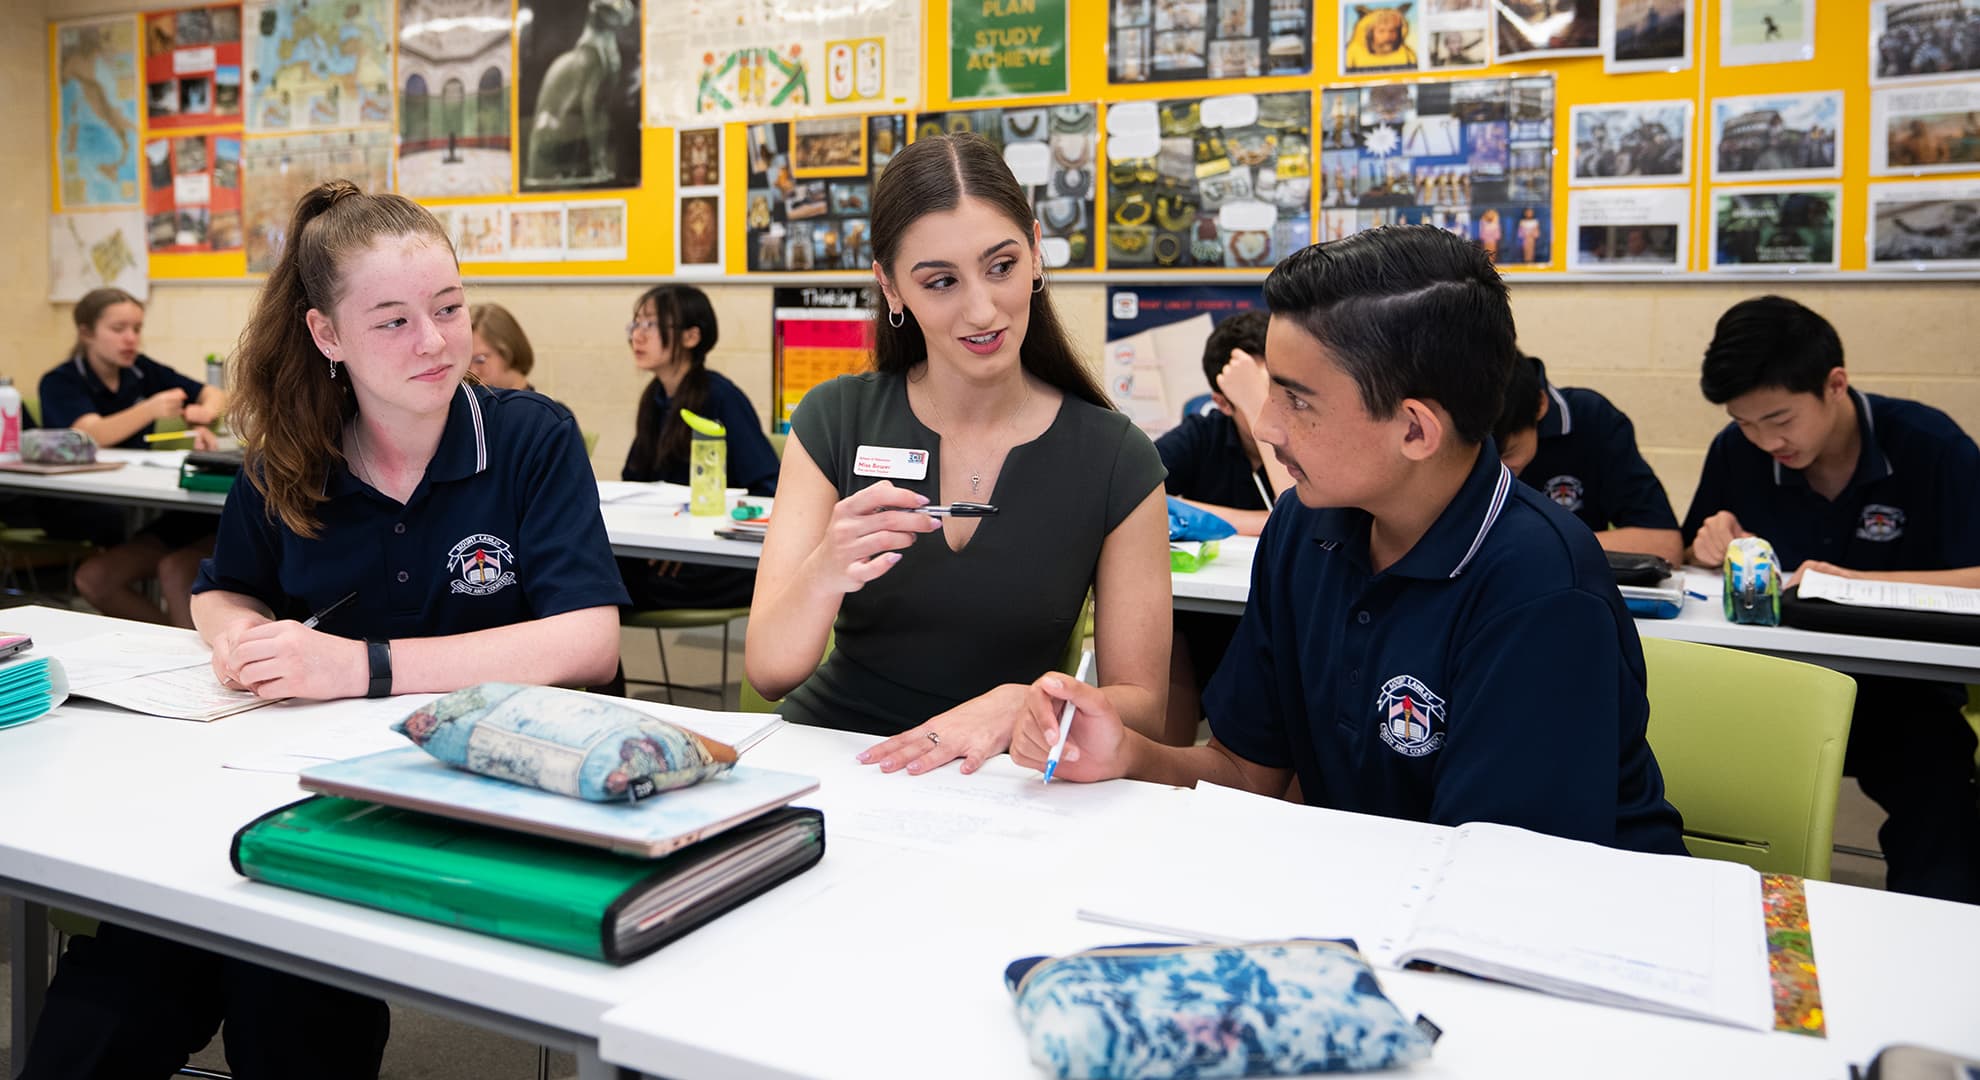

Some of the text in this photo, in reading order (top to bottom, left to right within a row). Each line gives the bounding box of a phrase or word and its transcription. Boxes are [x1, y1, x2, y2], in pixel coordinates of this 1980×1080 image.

[982, 0, 1035, 16] PLAN
[975, 25, 1043, 49] STUDY
[966, 46, 1052, 71] ACHIEVE
[801, 287, 857, 309] Thinking
[1407, 679, 1434, 701] LAWLEY
